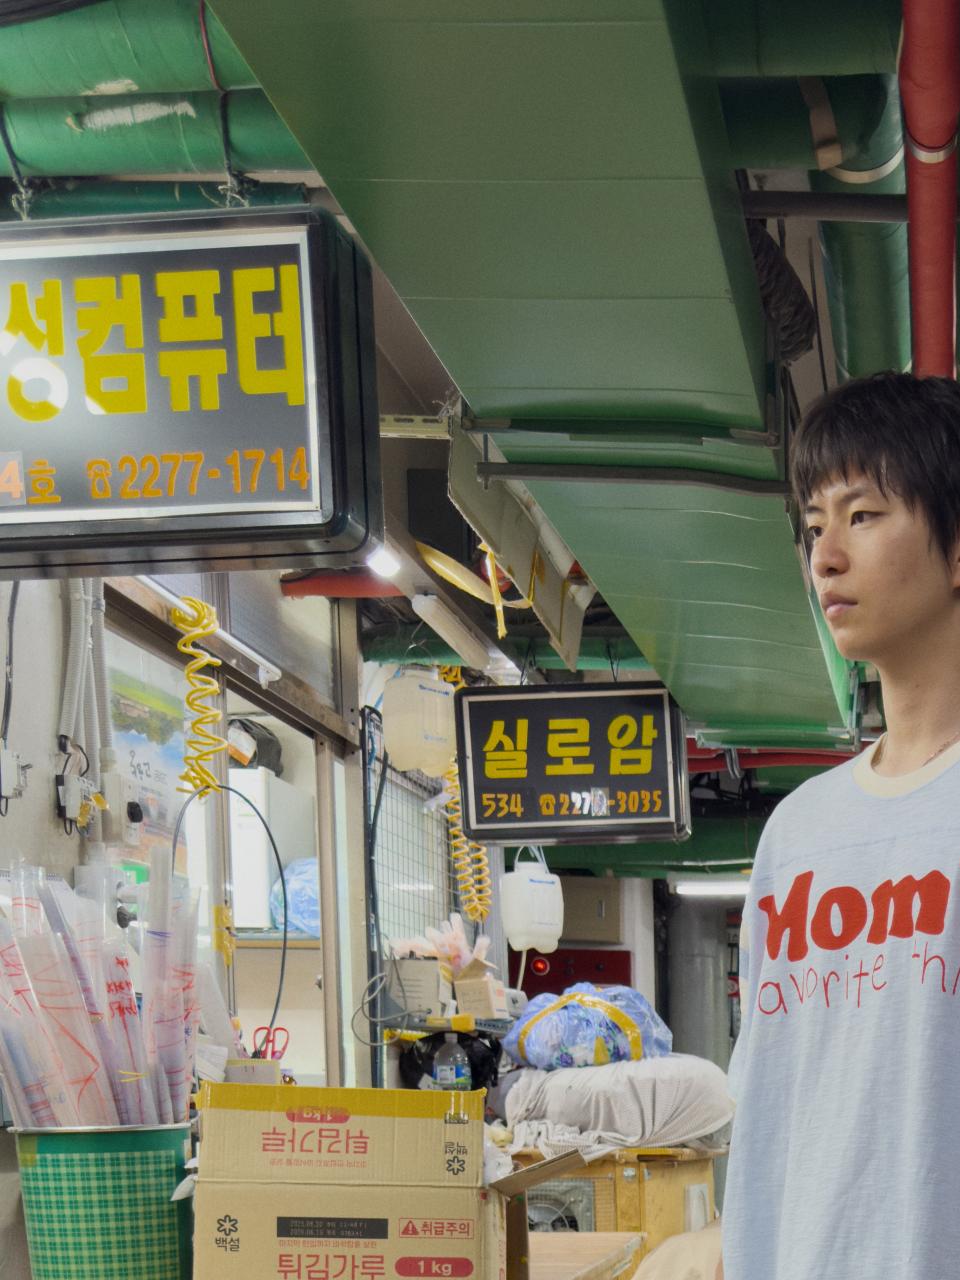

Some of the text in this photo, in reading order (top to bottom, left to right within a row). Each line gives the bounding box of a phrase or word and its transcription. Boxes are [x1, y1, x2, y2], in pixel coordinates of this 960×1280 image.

[0, 264, 306, 423] 성컴퓨터
[118, 447, 310, 498] 2277-1714
[483, 714, 658, 779] 실로암
[481, 793, 524, 818] 534
[261, 1126, 370, 1154] 튀김가루
[420, 1221, 471, 1236] 취급주의
[214, 1237, 240, 1252] 백설
[277, 1254, 452, 1280] 튀김가루 1 kg
